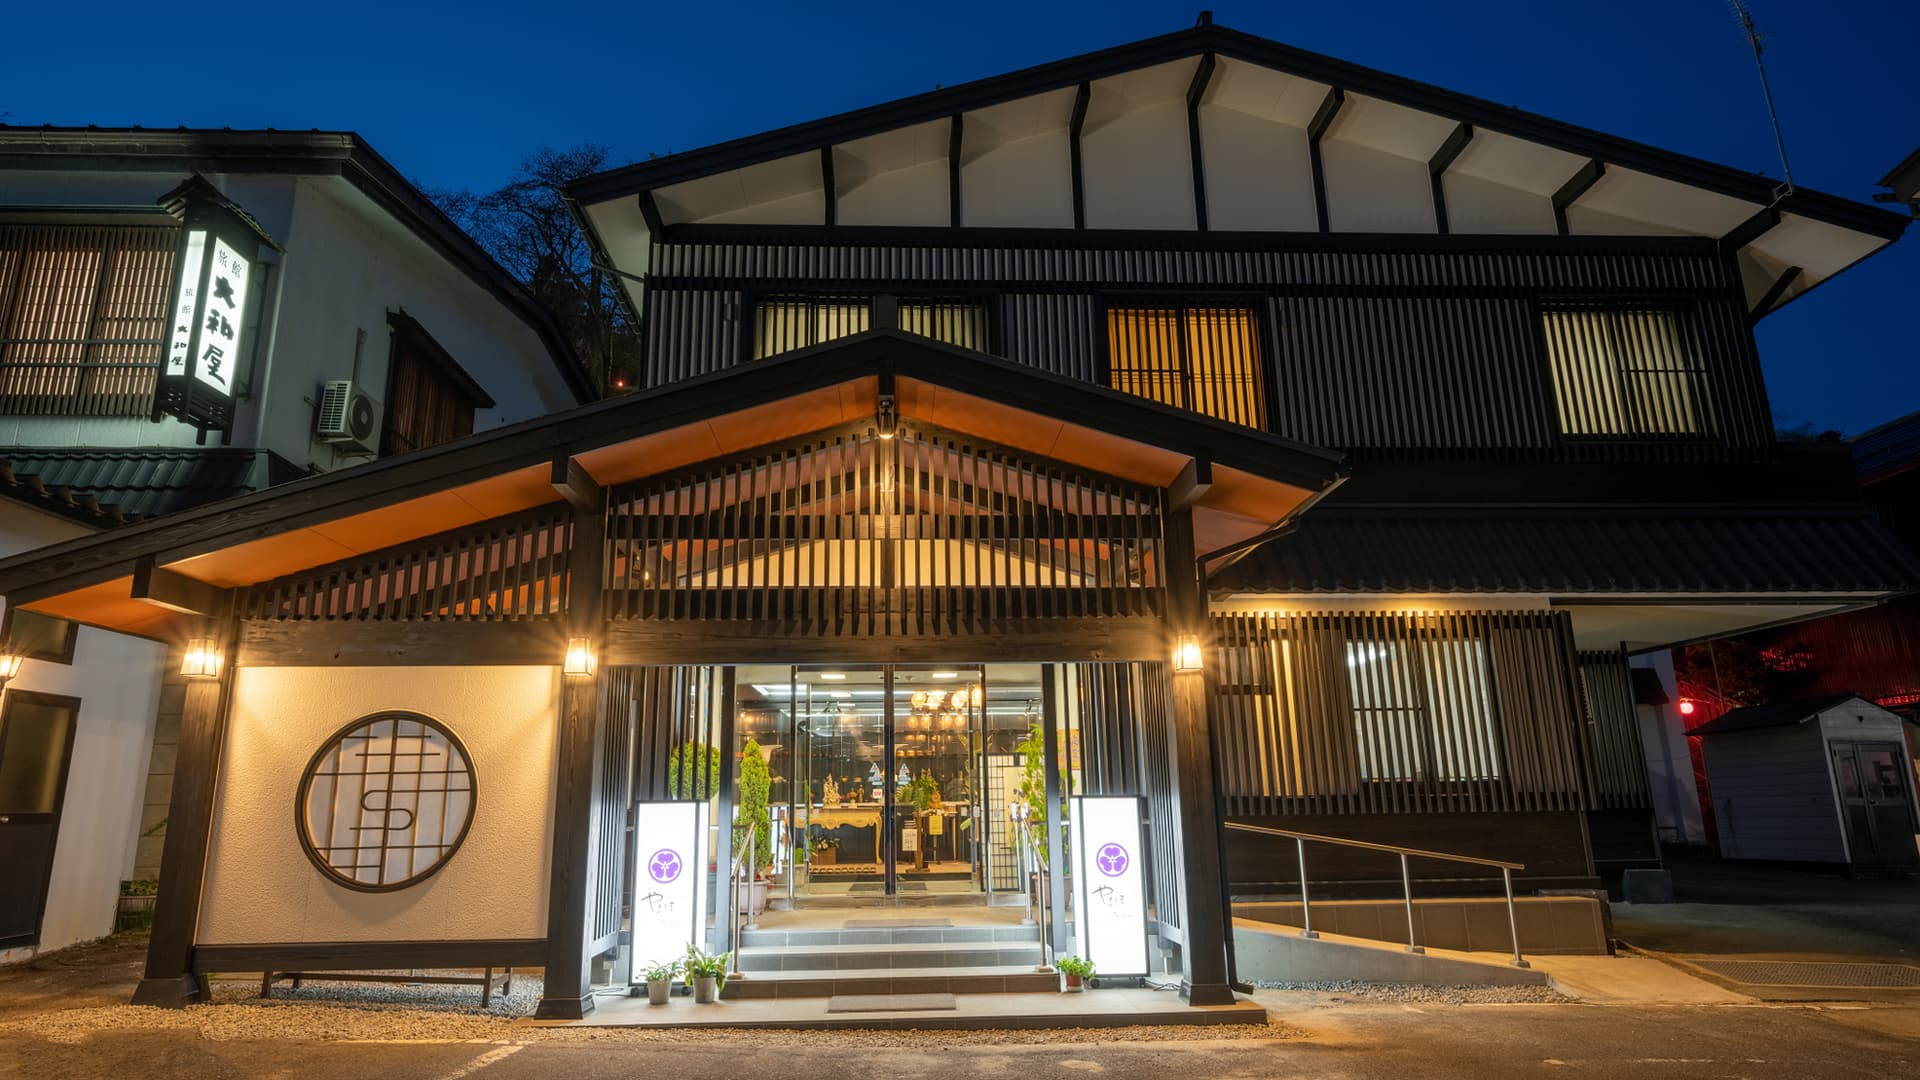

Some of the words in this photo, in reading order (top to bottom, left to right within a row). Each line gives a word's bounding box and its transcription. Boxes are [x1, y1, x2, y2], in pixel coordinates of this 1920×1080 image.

[218, 249, 242, 278] 旅館
[202, 275, 236, 386] 大和屋
